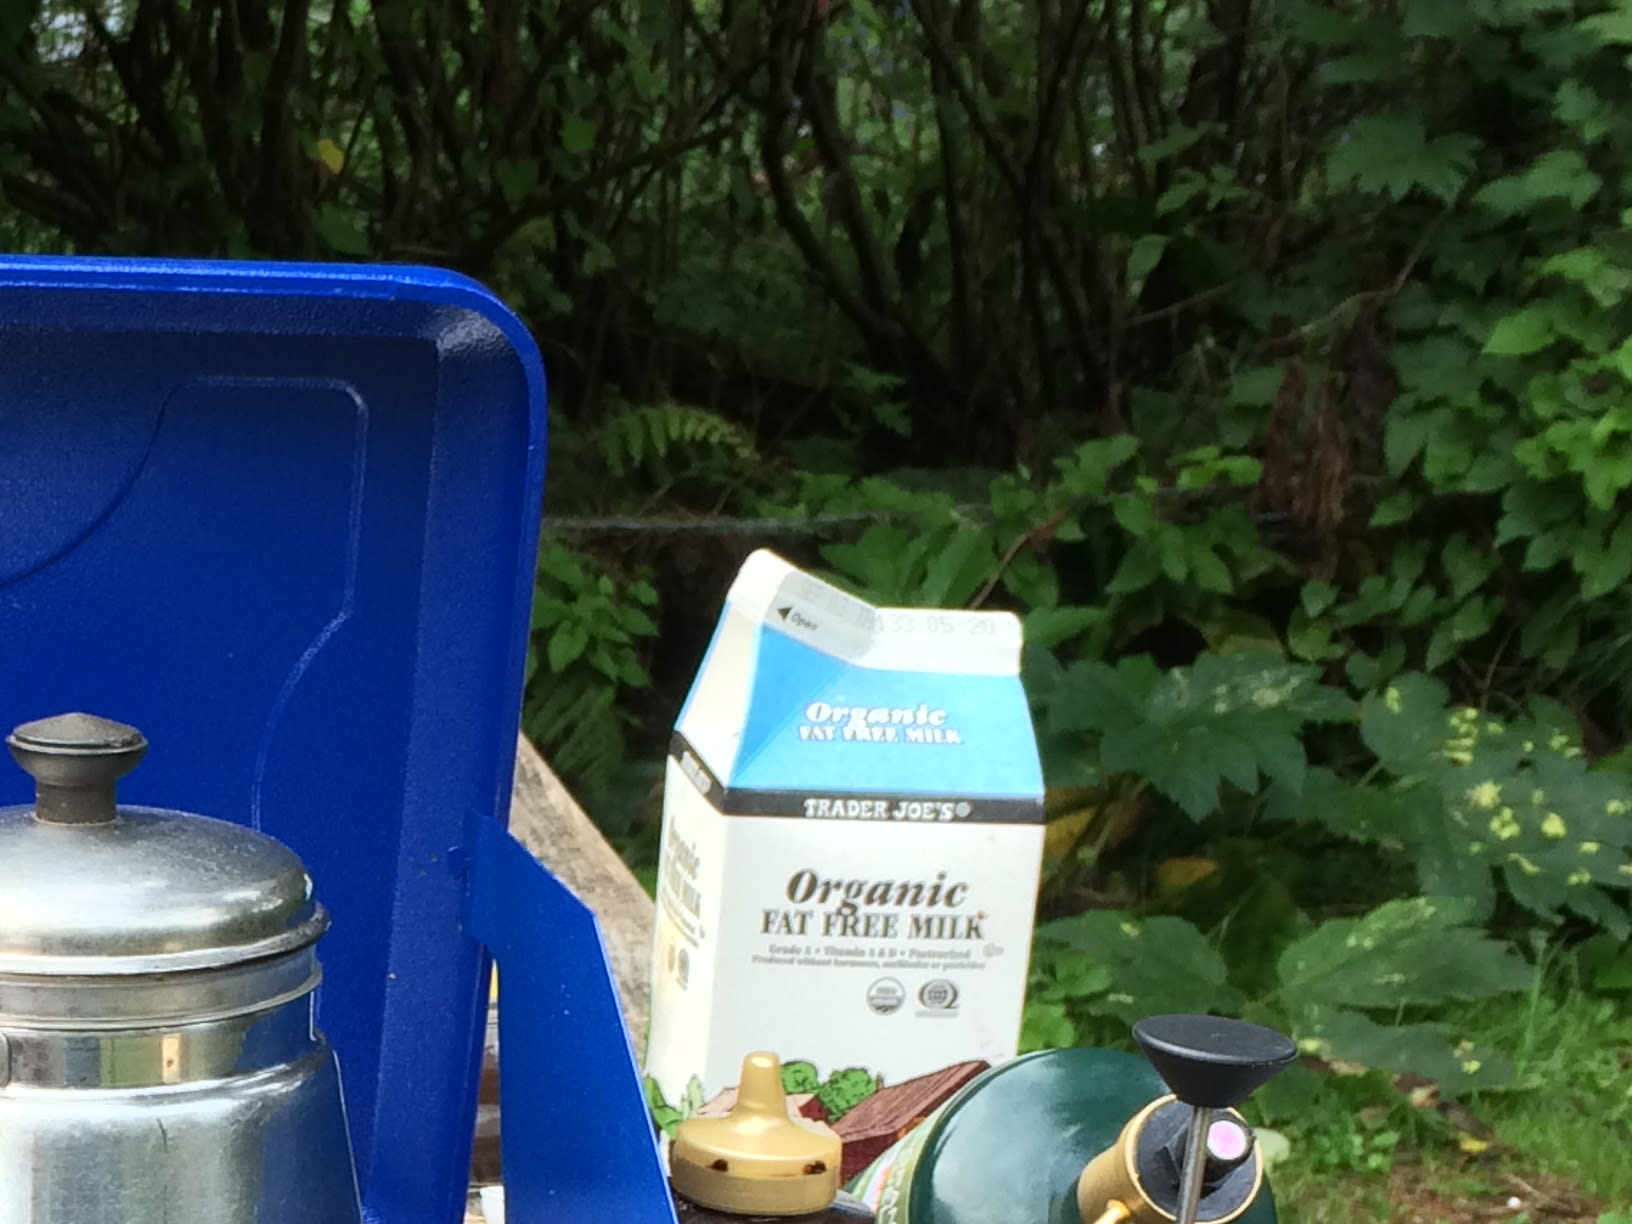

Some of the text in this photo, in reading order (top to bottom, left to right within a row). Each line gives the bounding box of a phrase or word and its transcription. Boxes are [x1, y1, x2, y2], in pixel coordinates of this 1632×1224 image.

[805, 702, 947, 729] Organic
[799, 725, 964, 744] FAT FREE MILK
[803, 798, 889, 820] TRADER
[786, 867, 969, 916] Organic
[760, 909, 985, 941] FAT FREE MILK
